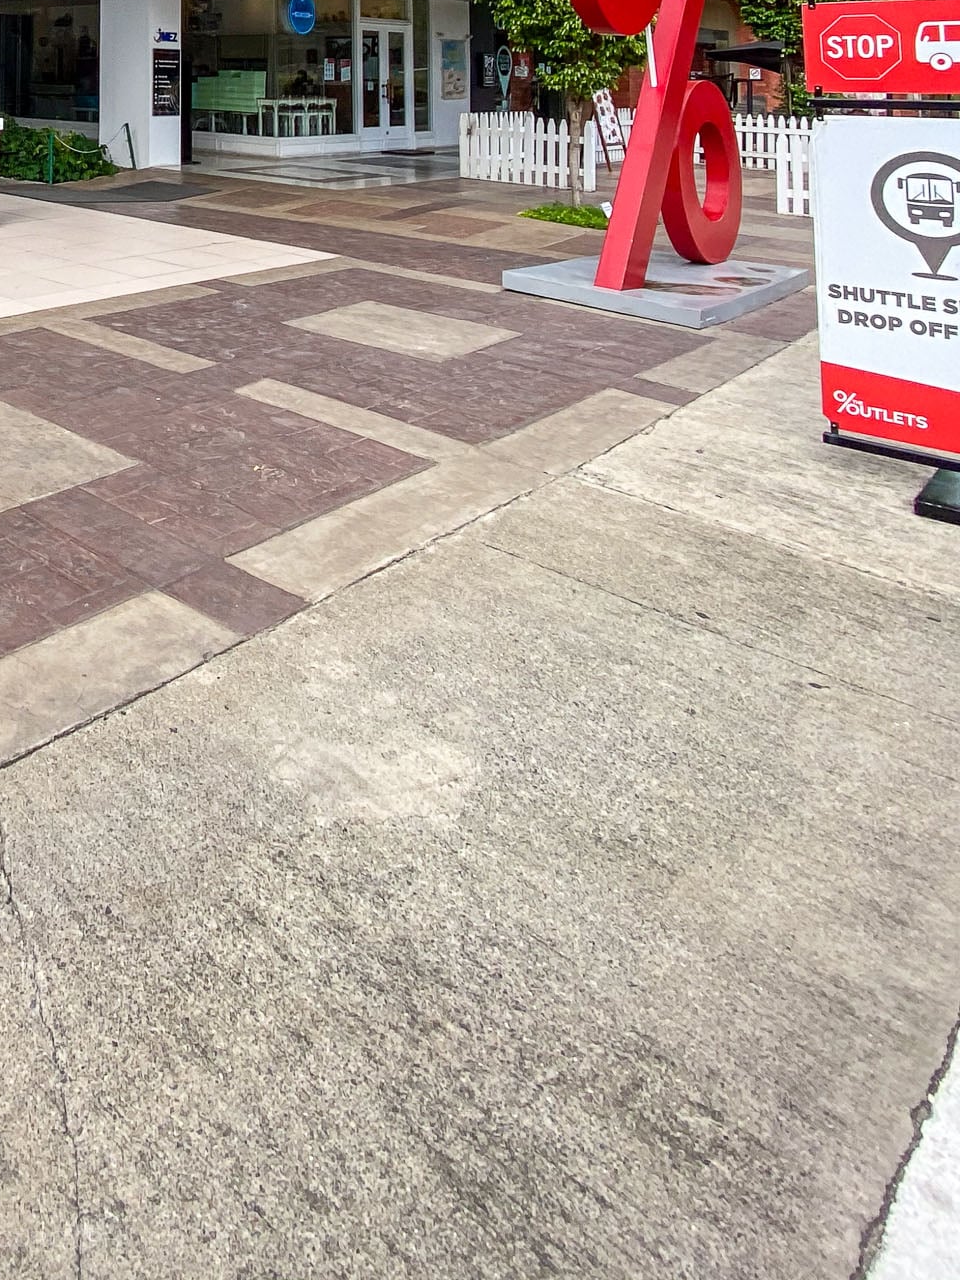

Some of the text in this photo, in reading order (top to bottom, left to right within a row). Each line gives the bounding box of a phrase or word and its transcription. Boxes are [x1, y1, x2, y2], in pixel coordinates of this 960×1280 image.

[826, 34, 894, 59] STOP
[828, 283, 960, 315] SHUTTLE S
[837, 309, 959, 340] DROP OFF
